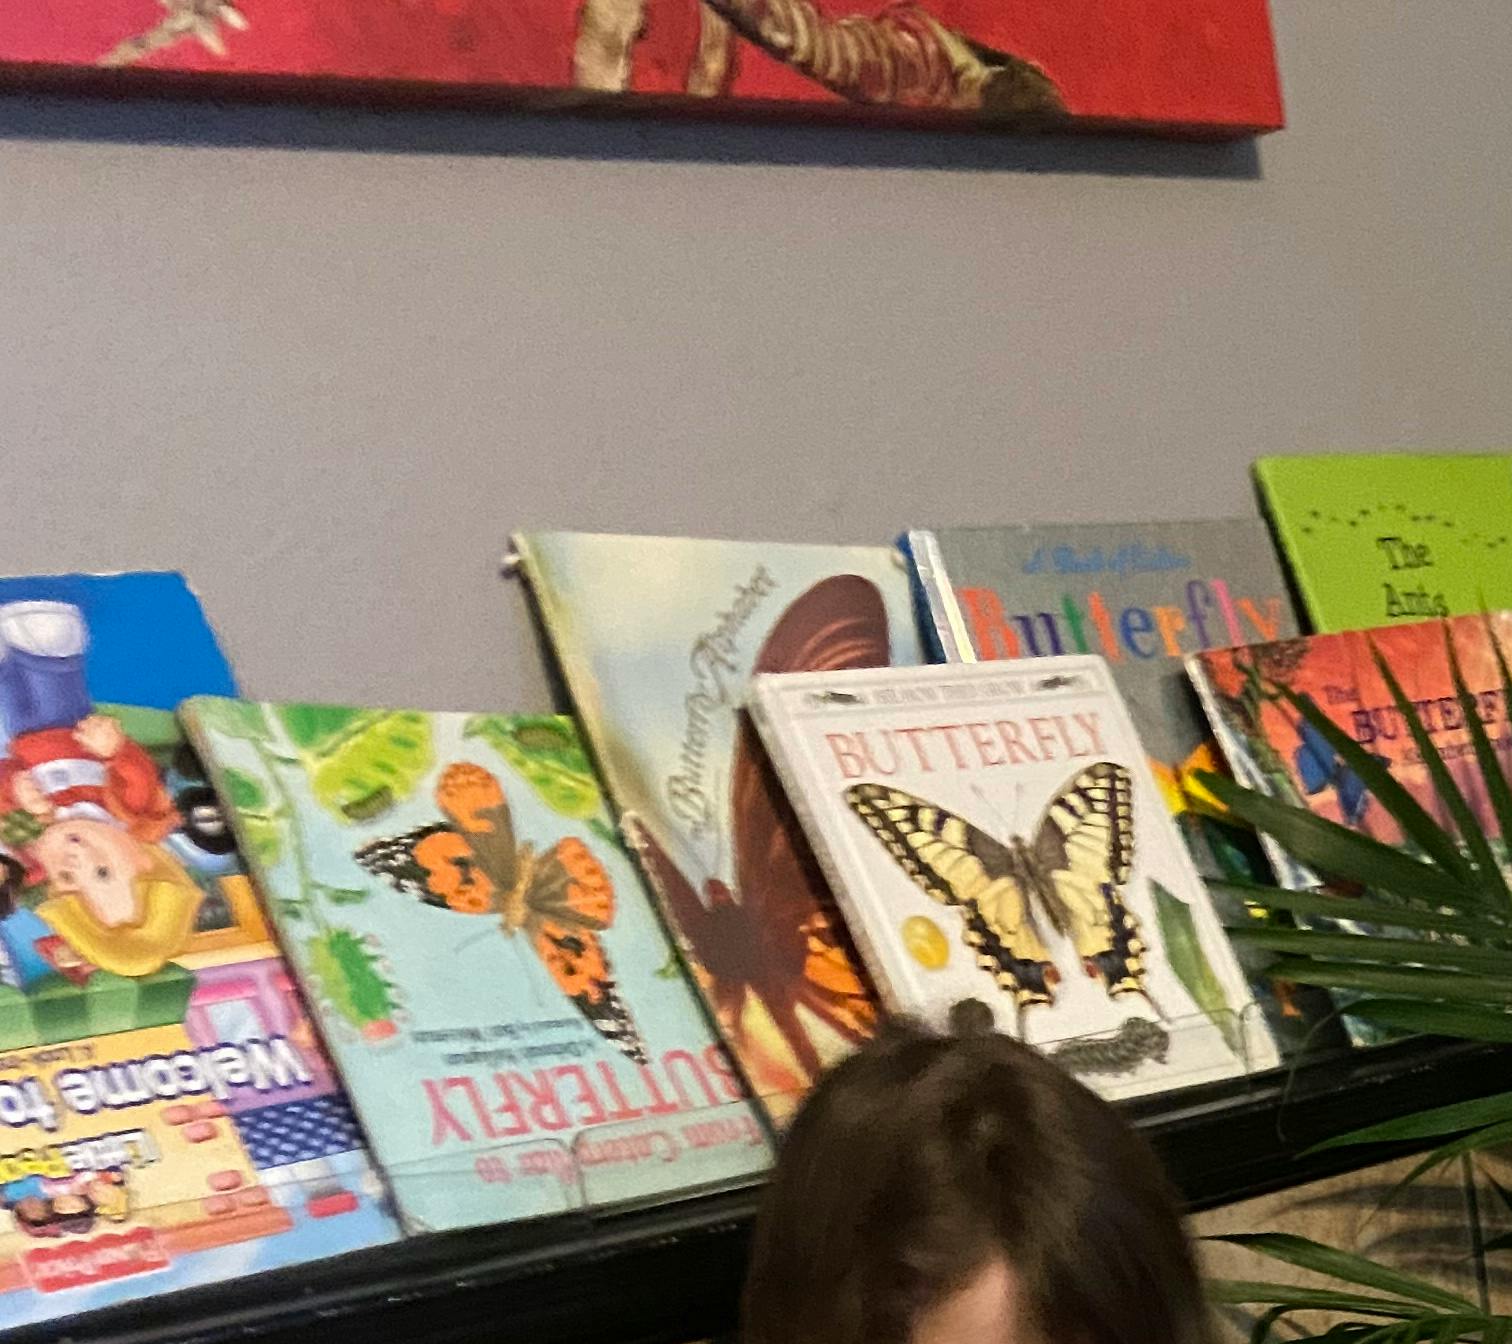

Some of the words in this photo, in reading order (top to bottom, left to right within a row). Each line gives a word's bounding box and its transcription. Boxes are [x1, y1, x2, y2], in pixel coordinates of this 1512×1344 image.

[1376, 535, 1436, 570] The
[962, 577, 1283, 664] Butterfly
[1383, 583, 1451, 617] Ants
[824, 709, 1109, 782] BUTTERFLY
[0, 1075, 58, 1134] to
[54, 1036, 314, 1116] Welcome
[421, 1044, 741, 1145] BUTTERFLY
